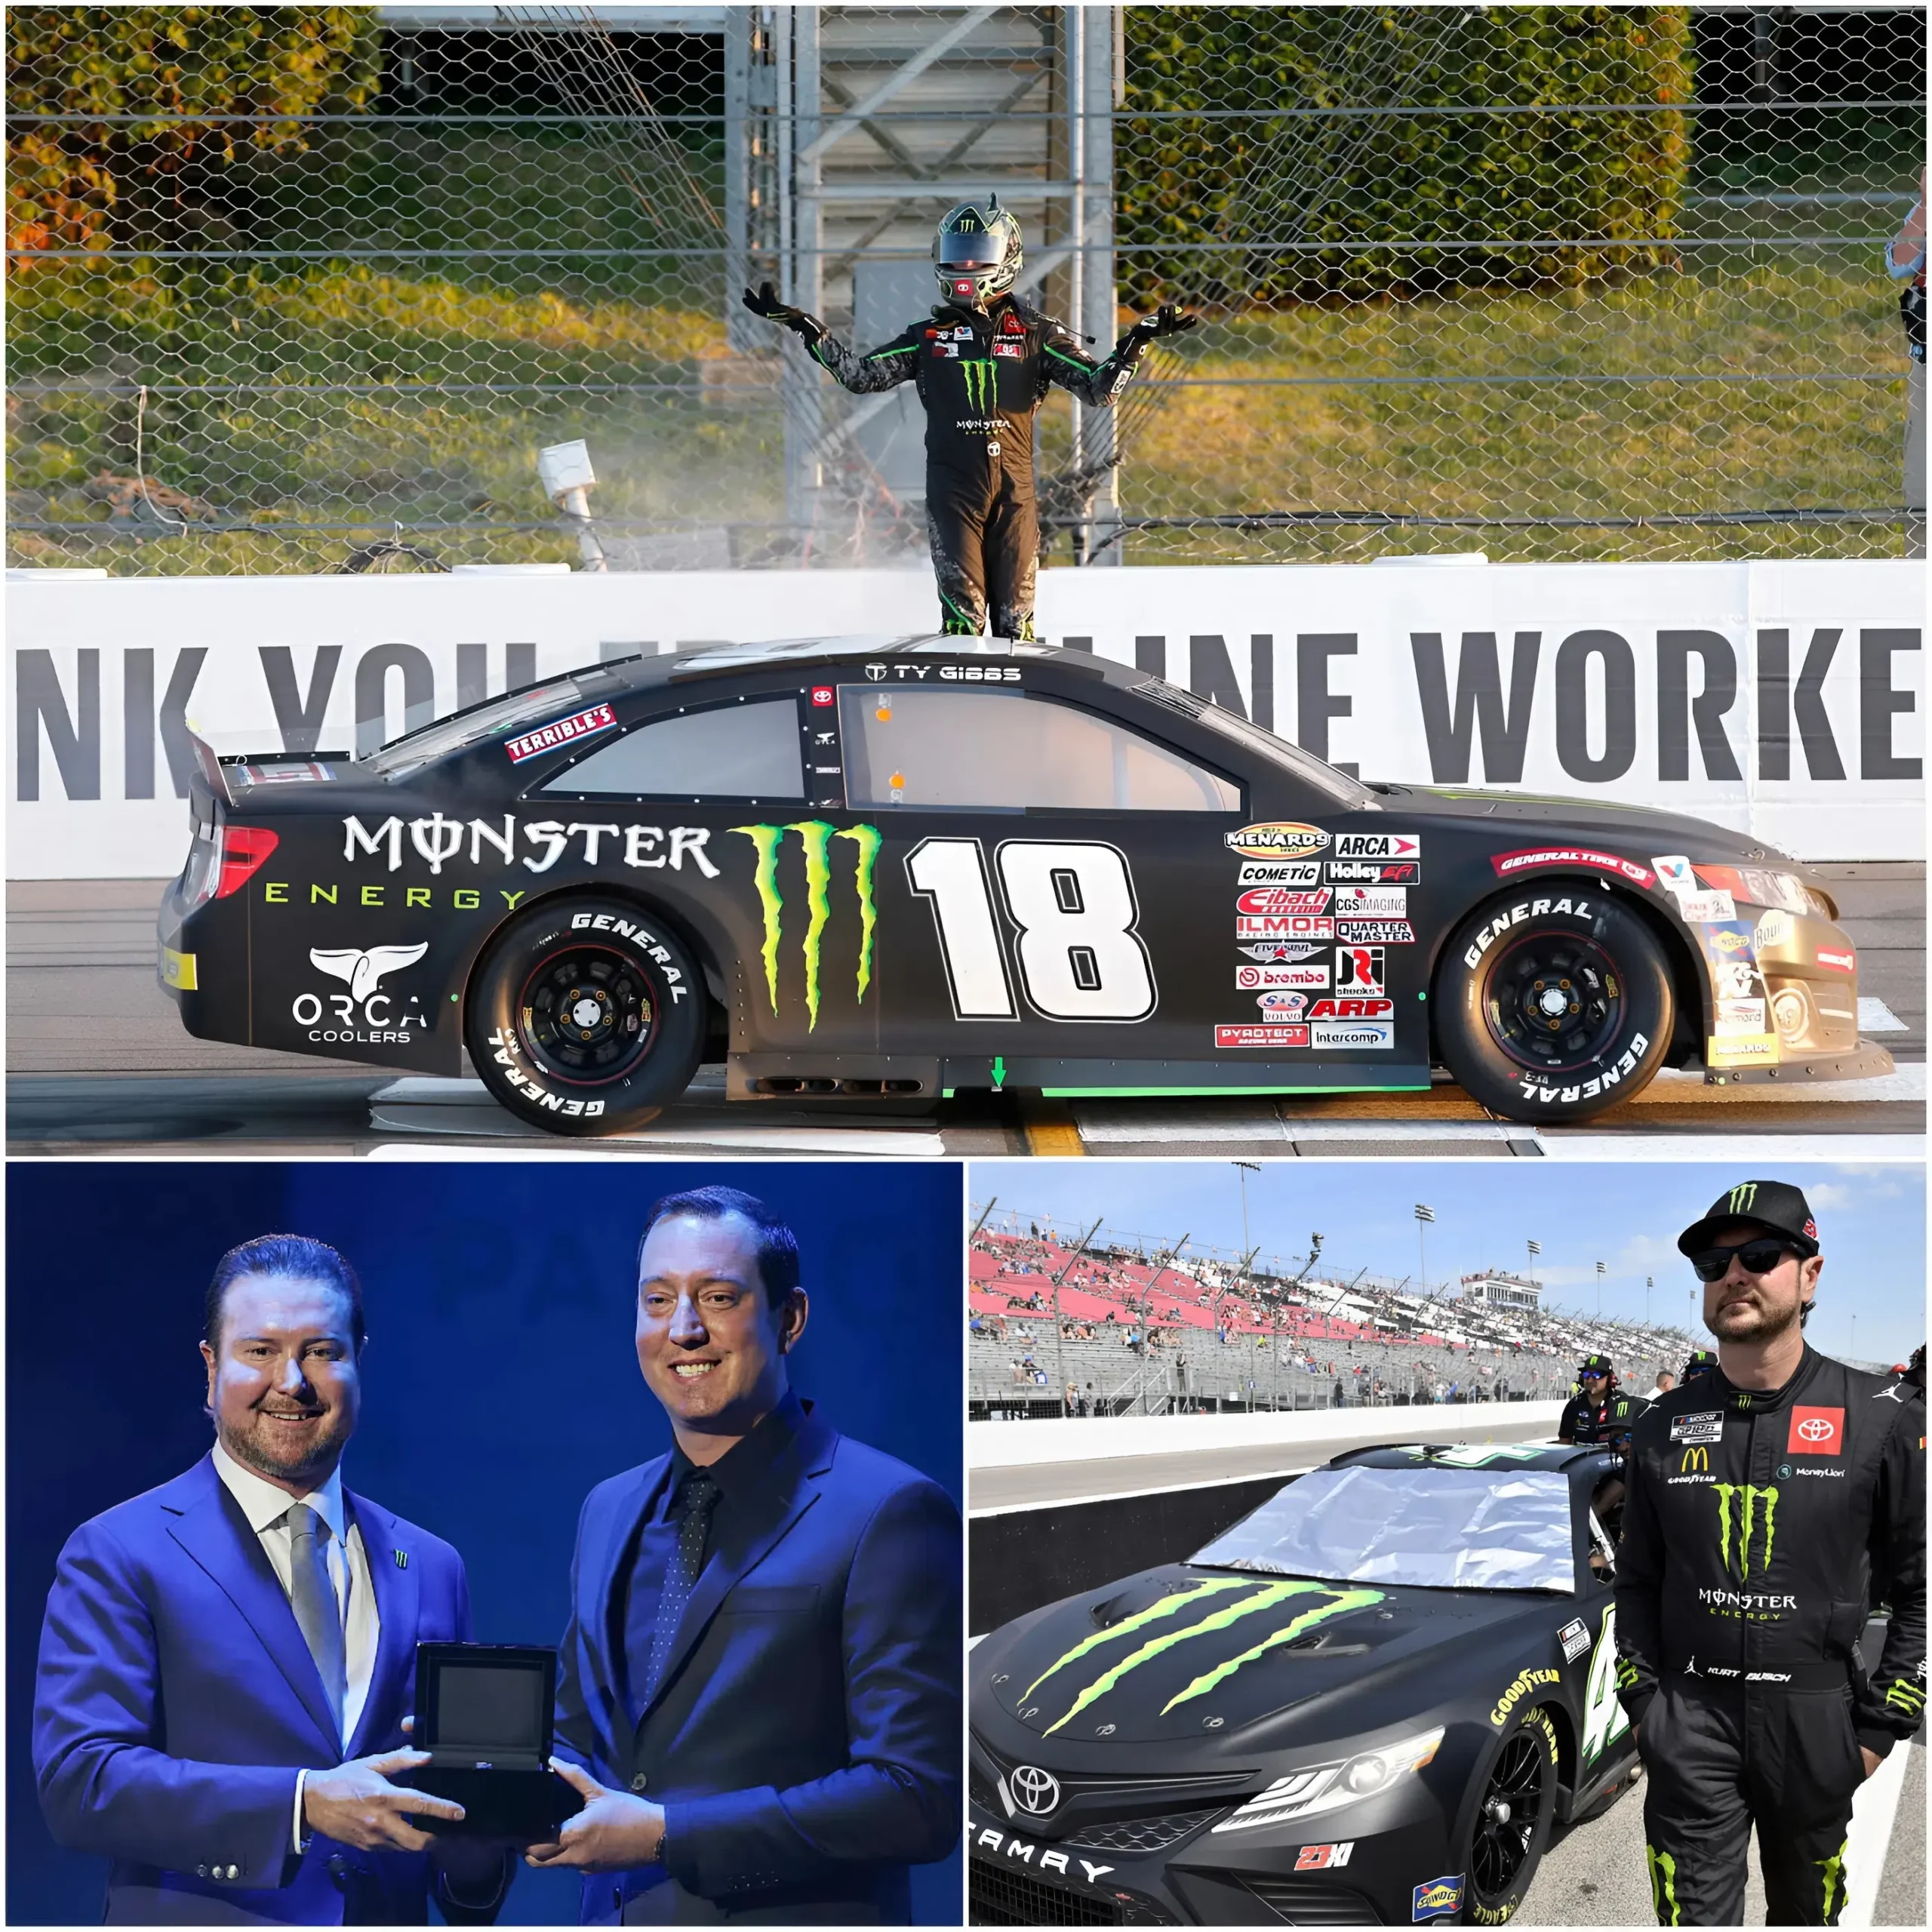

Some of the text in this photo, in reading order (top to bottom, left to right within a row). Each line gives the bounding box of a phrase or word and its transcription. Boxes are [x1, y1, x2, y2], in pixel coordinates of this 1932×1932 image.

[894, 665, 931, 679] TY
[1409, 628, 1924, 785] WORKE
[509, 707, 611, 757] TERRIBLE'S
[1226, 832, 1329, 847] MENARDS
[1338, 837, 1389, 856] ARCA
[1500, 851, 1579, 870] GENERAL
[1330, 863, 1381, 883] Holley
[265, 882, 525, 910] ENERGY
[1238, 888, 1331, 912] Eibach
[903, 837, 1158, 1023] 18
[1238, 917, 1333, 932] ILMOR
[1338, 921, 1408, 937] QUARTER
[1463, 898, 1593, 970] GENERAL
[1350, 932, 1412, 943] MASTER
[571, 913, 688, 1004] GENERAL
[1264, 970, 1325, 984] brembo
[1309, 999, 1393, 1017] ARP
[309, 1030, 411, 1043] COOLERS
[488, 1026, 605, 1117] GENERAL
[1518, 1032, 1649, 1103] GENERAL
[1707, 1666, 1741, 1678] KURT
[1582, 1601, 1630, 1769] 4
[969, 1821, 1115, 1884] AMRY
